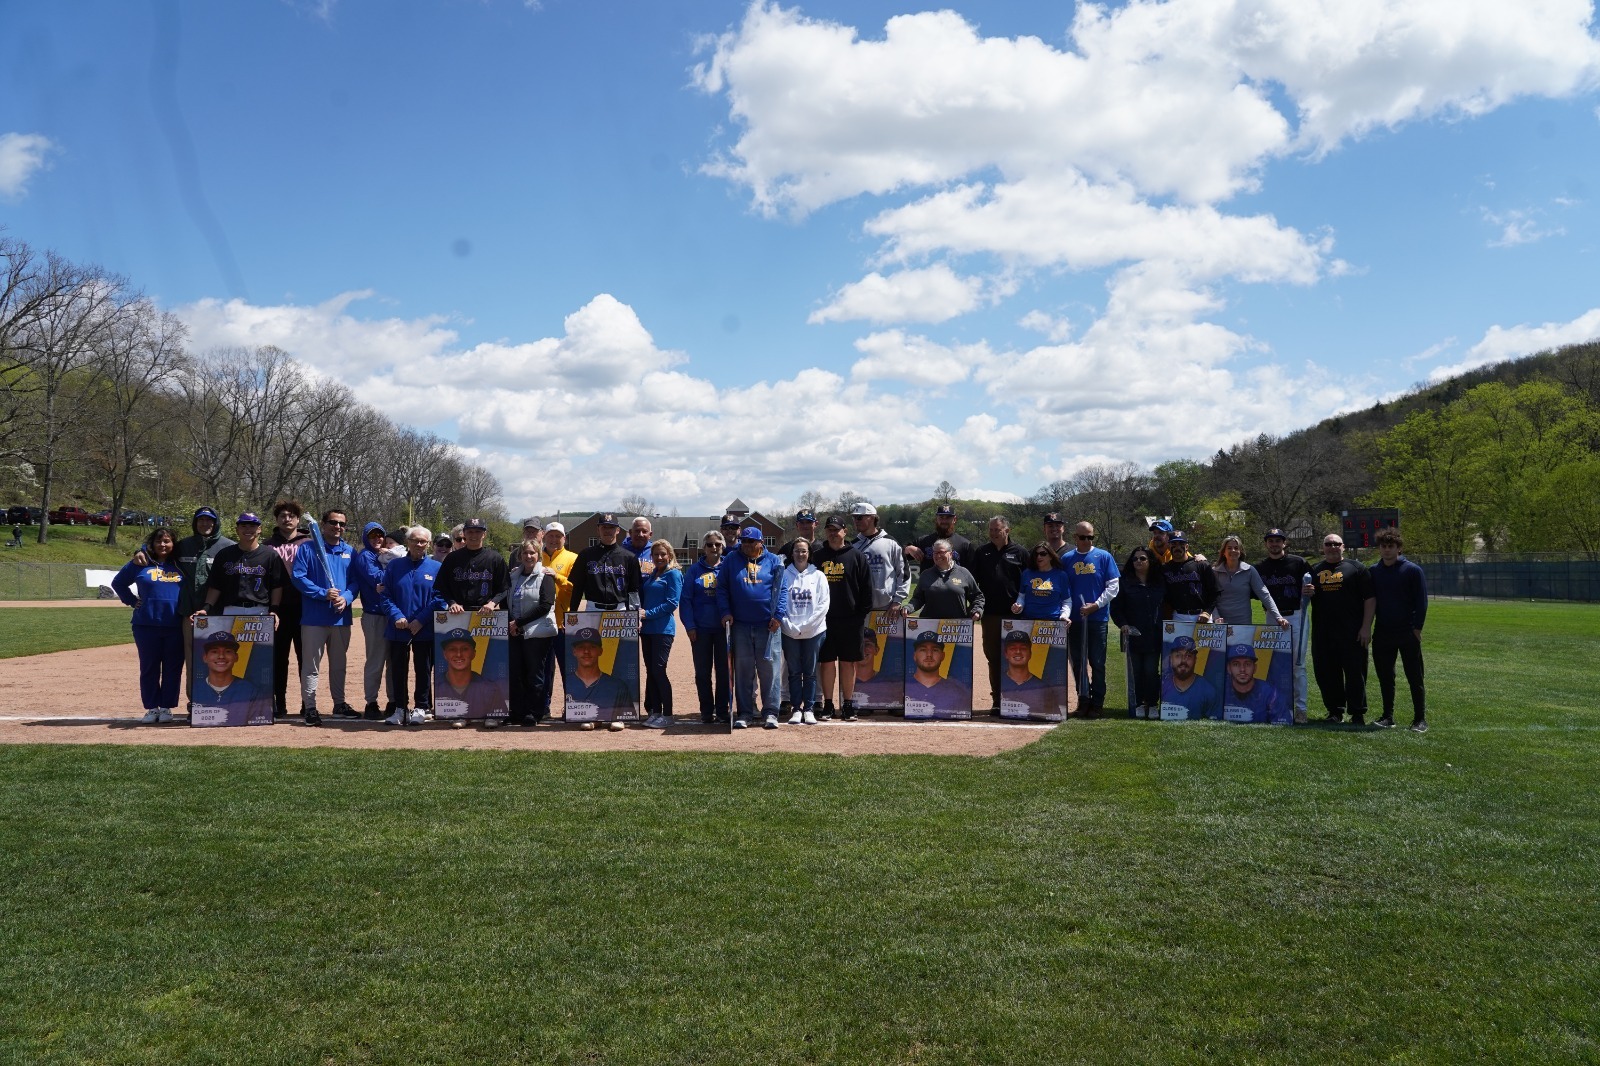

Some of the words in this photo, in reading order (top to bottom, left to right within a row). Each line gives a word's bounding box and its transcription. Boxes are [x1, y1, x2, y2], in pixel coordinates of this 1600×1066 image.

[223, 561, 266, 576] Bobcats
[587, 561, 627, 575] Bobcats
[821, 560, 845, 575] Pitt
[1073, 561, 1097, 575] Pitt
[146, 567, 182, 583] Pitt
[453, 567, 493, 581] Bobcats
[1317, 569, 1344, 584] Pitt
[254, 577, 262, 592] 7
[1030, 577, 1054, 590] Pitt
[789, 587, 812, 600] Pitt
[480, 617, 498, 626] BEN
[602, 618, 636, 627] HUNTER
[244, 622, 262, 631] NEO
[877, 626, 897, 634] LITTS
[941, 625, 970, 633] CALVIN
[1038, 627, 1060, 635] COLIN
[470, 627, 508, 636] AFTANAS
[602, 629, 637, 638] GIDEONS
[1197, 630, 1224, 638] TOMMY
[1260, 631, 1283, 639] MATT
[236, 632, 270, 642] MILLER
[937, 634, 972, 643] BERNARD
[1032, 636, 1066, 645] SOLINSKI
[1198, 640, 1222, 648] SMITH
[1254, 641, 1291, 649] MAZZARA
